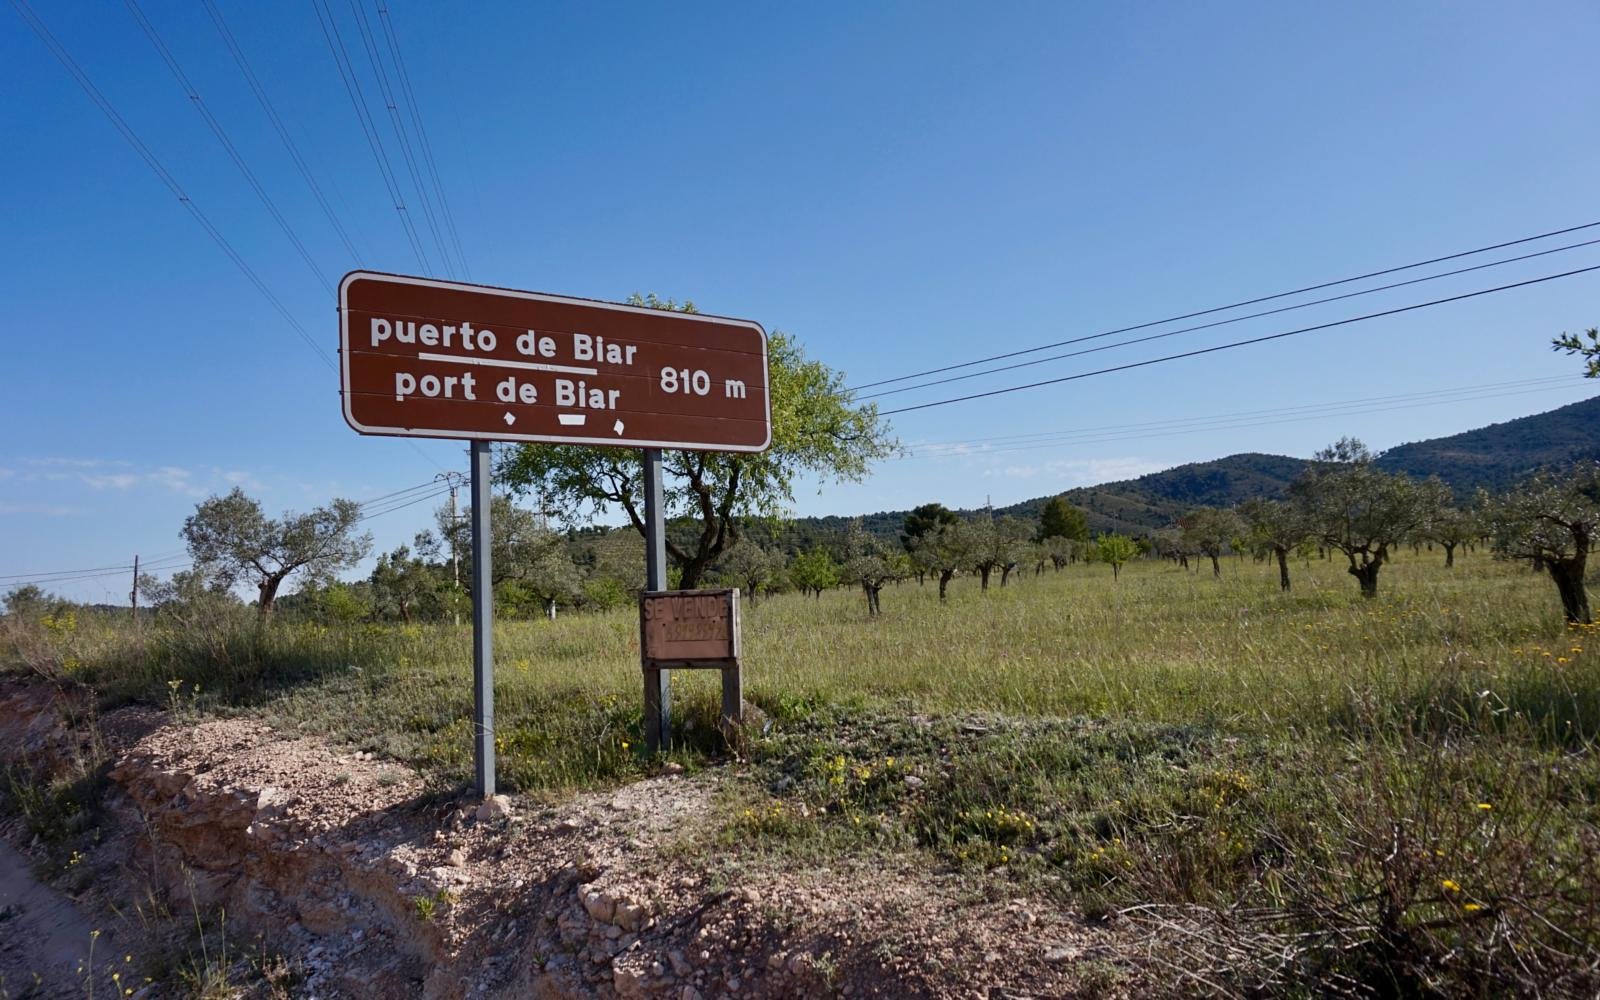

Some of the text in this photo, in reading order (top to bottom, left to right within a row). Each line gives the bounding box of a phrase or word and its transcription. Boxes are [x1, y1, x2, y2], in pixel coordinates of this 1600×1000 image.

[370, 317, 638, 366] puerto de Biar
[394, 371, 622, 411] port de Biar
[659, 366, 747, 400] 810 m
[644, 597, 664, 620] SE
